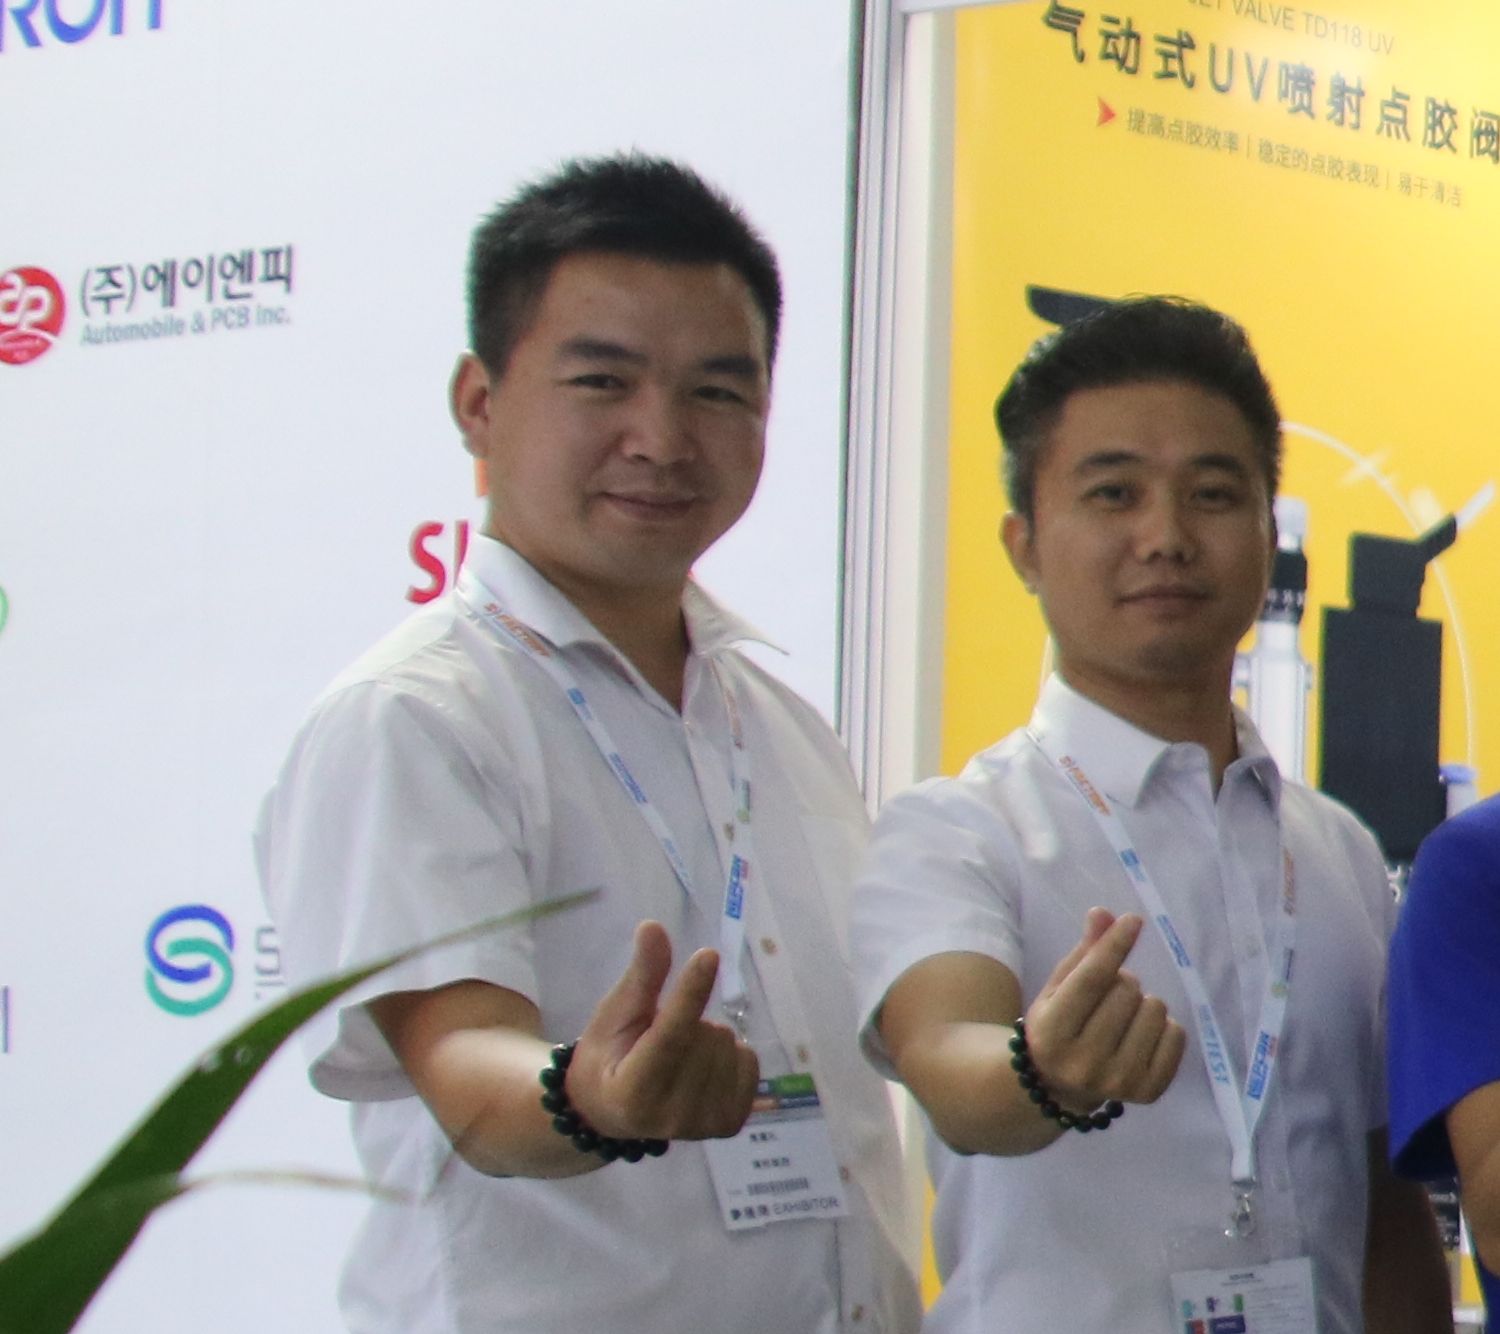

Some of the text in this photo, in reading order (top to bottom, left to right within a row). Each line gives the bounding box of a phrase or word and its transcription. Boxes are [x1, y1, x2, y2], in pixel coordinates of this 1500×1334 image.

[1302, 12, 1362, 49] TD118
[1367, 28, 1395, 55] UV
[1127, 106, 1240, 155] 提高点胶效率
[1258, 140, 1380, 190] 稳定的点胶表现
[80, 244, 293, 317] (주)에이엔피
[81, 319, 186, 346] Automobile
[211, 306, 250, 331] PCB
[772, 1195, 841, 1215] EXHIBITOR
